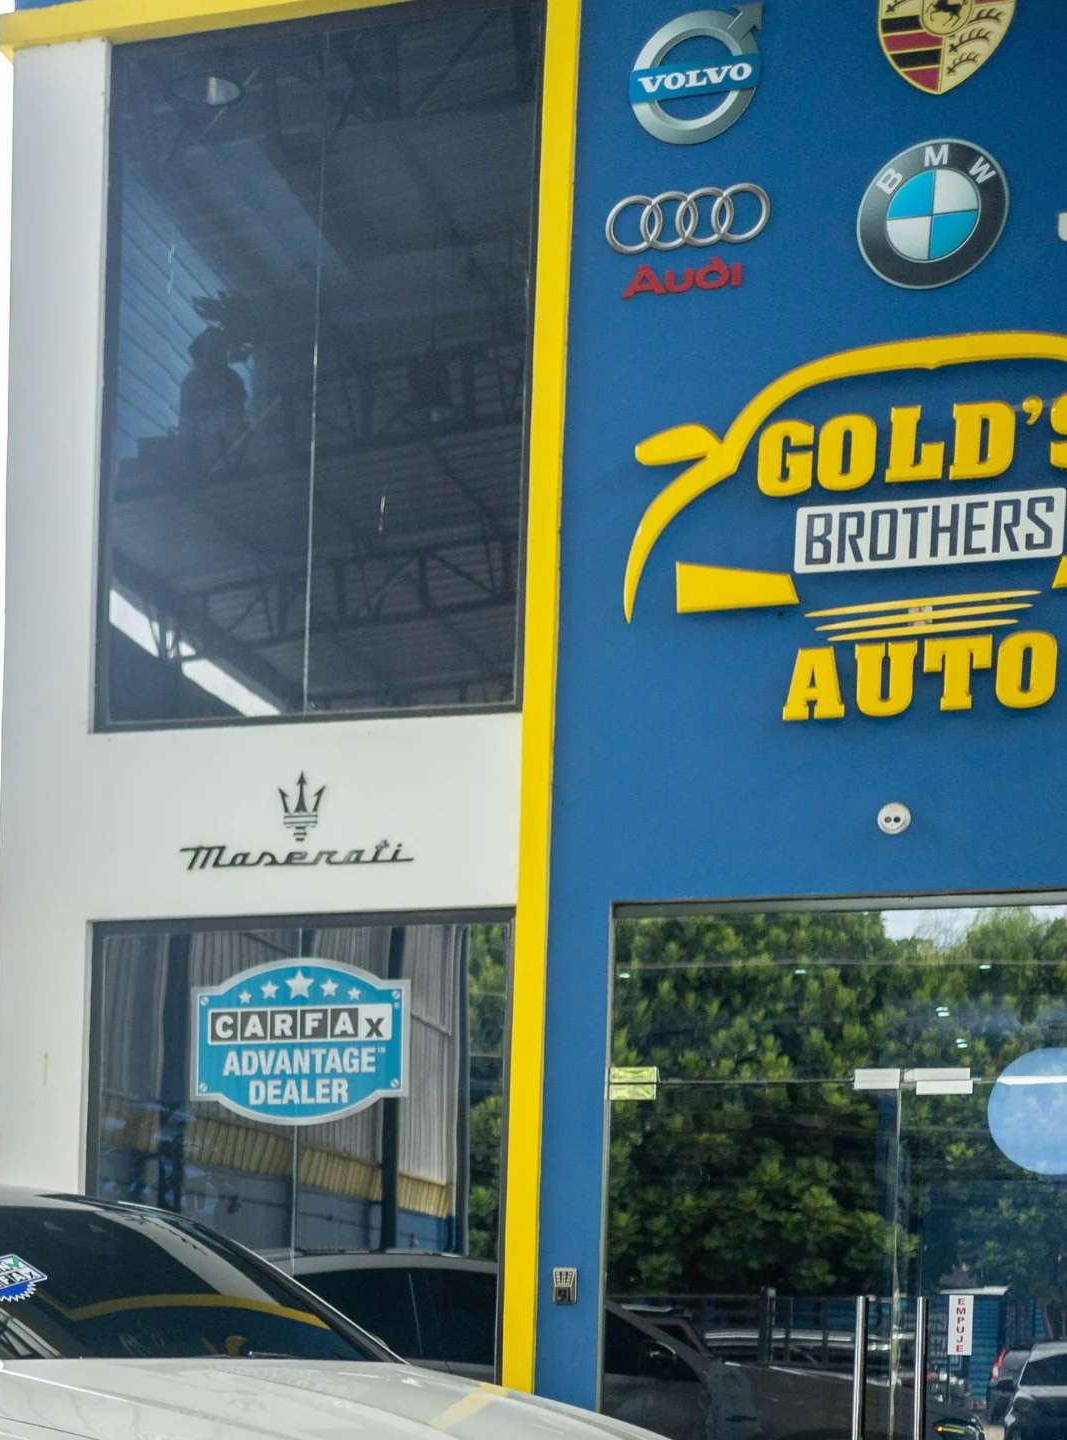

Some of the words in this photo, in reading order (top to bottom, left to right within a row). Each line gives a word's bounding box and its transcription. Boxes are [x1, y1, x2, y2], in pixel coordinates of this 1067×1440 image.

[637, 62, 753, 94] VOLVO
[875, 145, 996, 195] BMW
[622, 258, 742, 299] Audi
[804, 495, 1056, 566] BROTHERS
[782, 630, 1058, 721] AUTO
[180, 840, 414, 870] Maserati
[214, 1010, 384, 1039] CARFAX
[222, 1046, 376, 1076] ADVANTAGE
[248, 1079, 349, 1105] DEALER
[956, 1298, 967, 1352] EMPUJE
